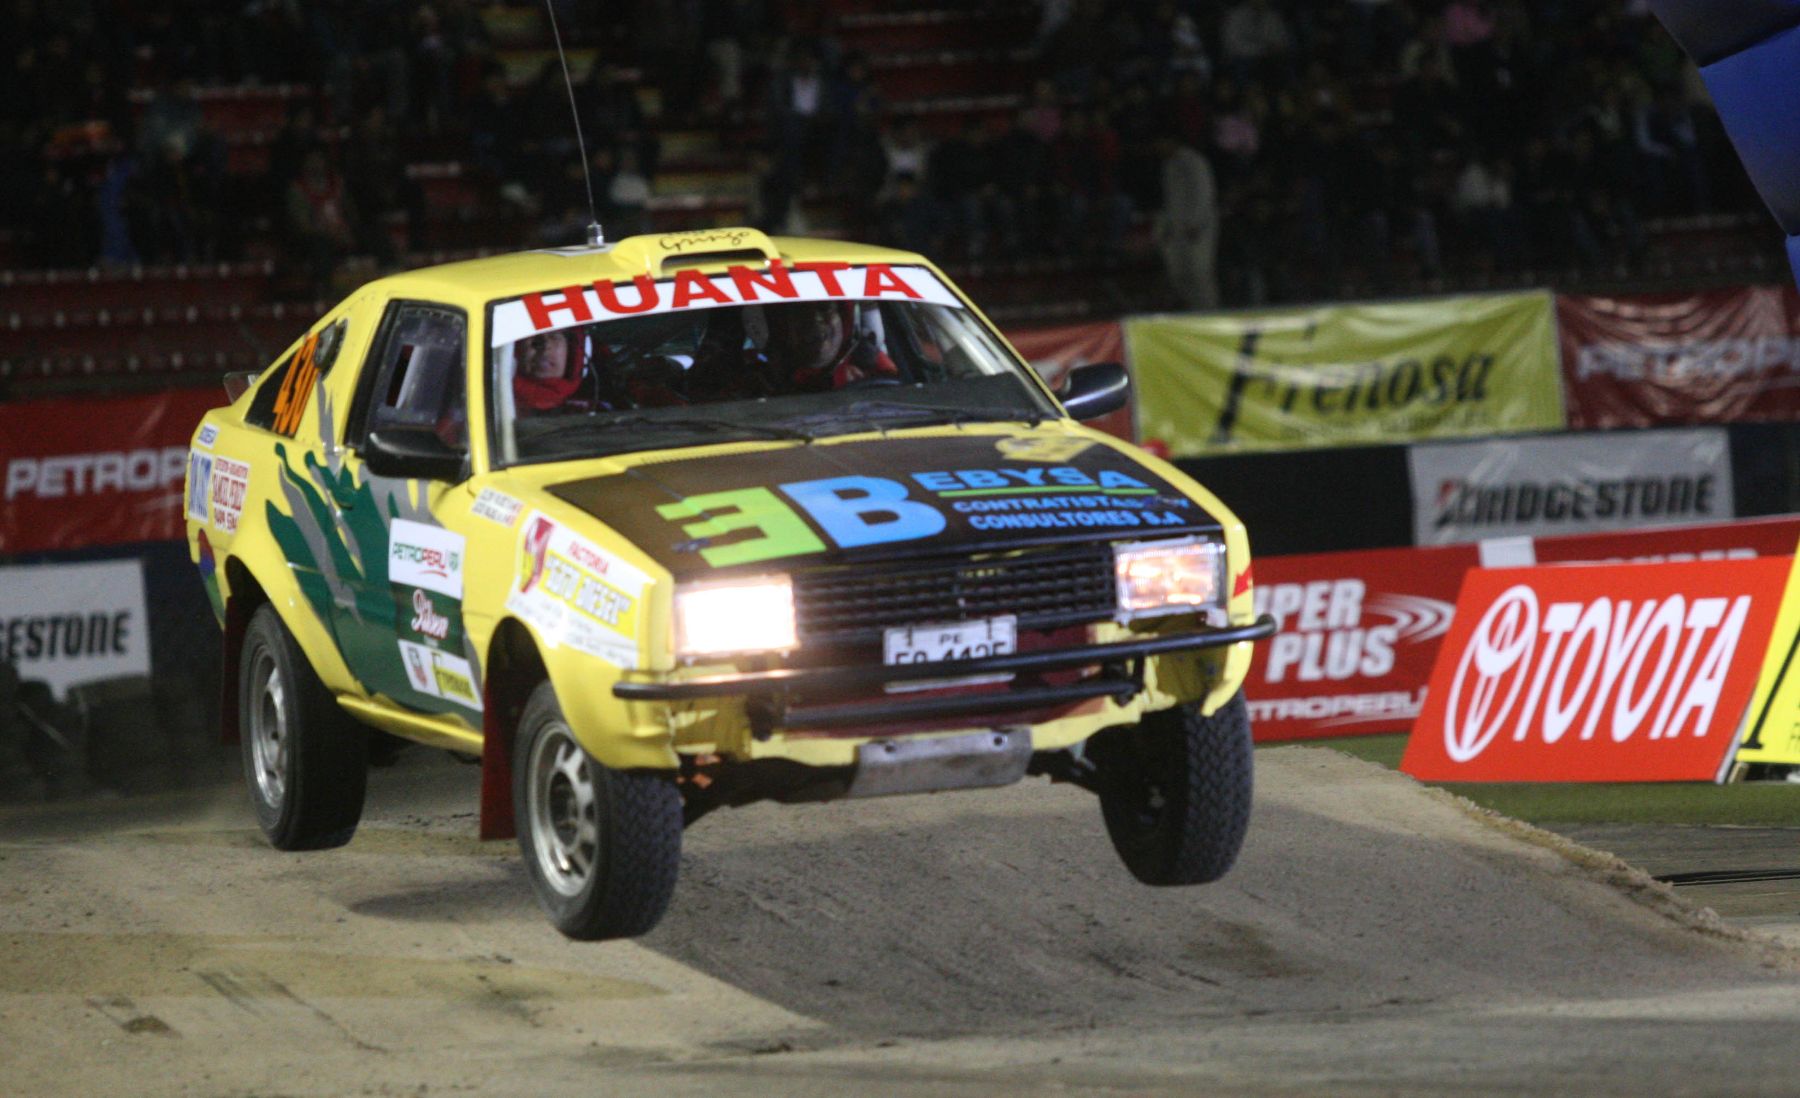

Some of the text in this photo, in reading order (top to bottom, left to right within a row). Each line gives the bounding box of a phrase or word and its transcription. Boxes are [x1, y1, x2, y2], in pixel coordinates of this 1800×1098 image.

[521, 259, 924, 331] HUANTA
[1206, 322, 1495, 446] Frenosa
[911, 466, 1151, 492] EBYSA
[1434, 474, 1716, 529] BRIDGESTONE
[967, 509, 1140, 530] CONSULTORES
[1264, 623, 1401, 684] PLUS
[1512, 592, 1752, 744] TOYOTA
